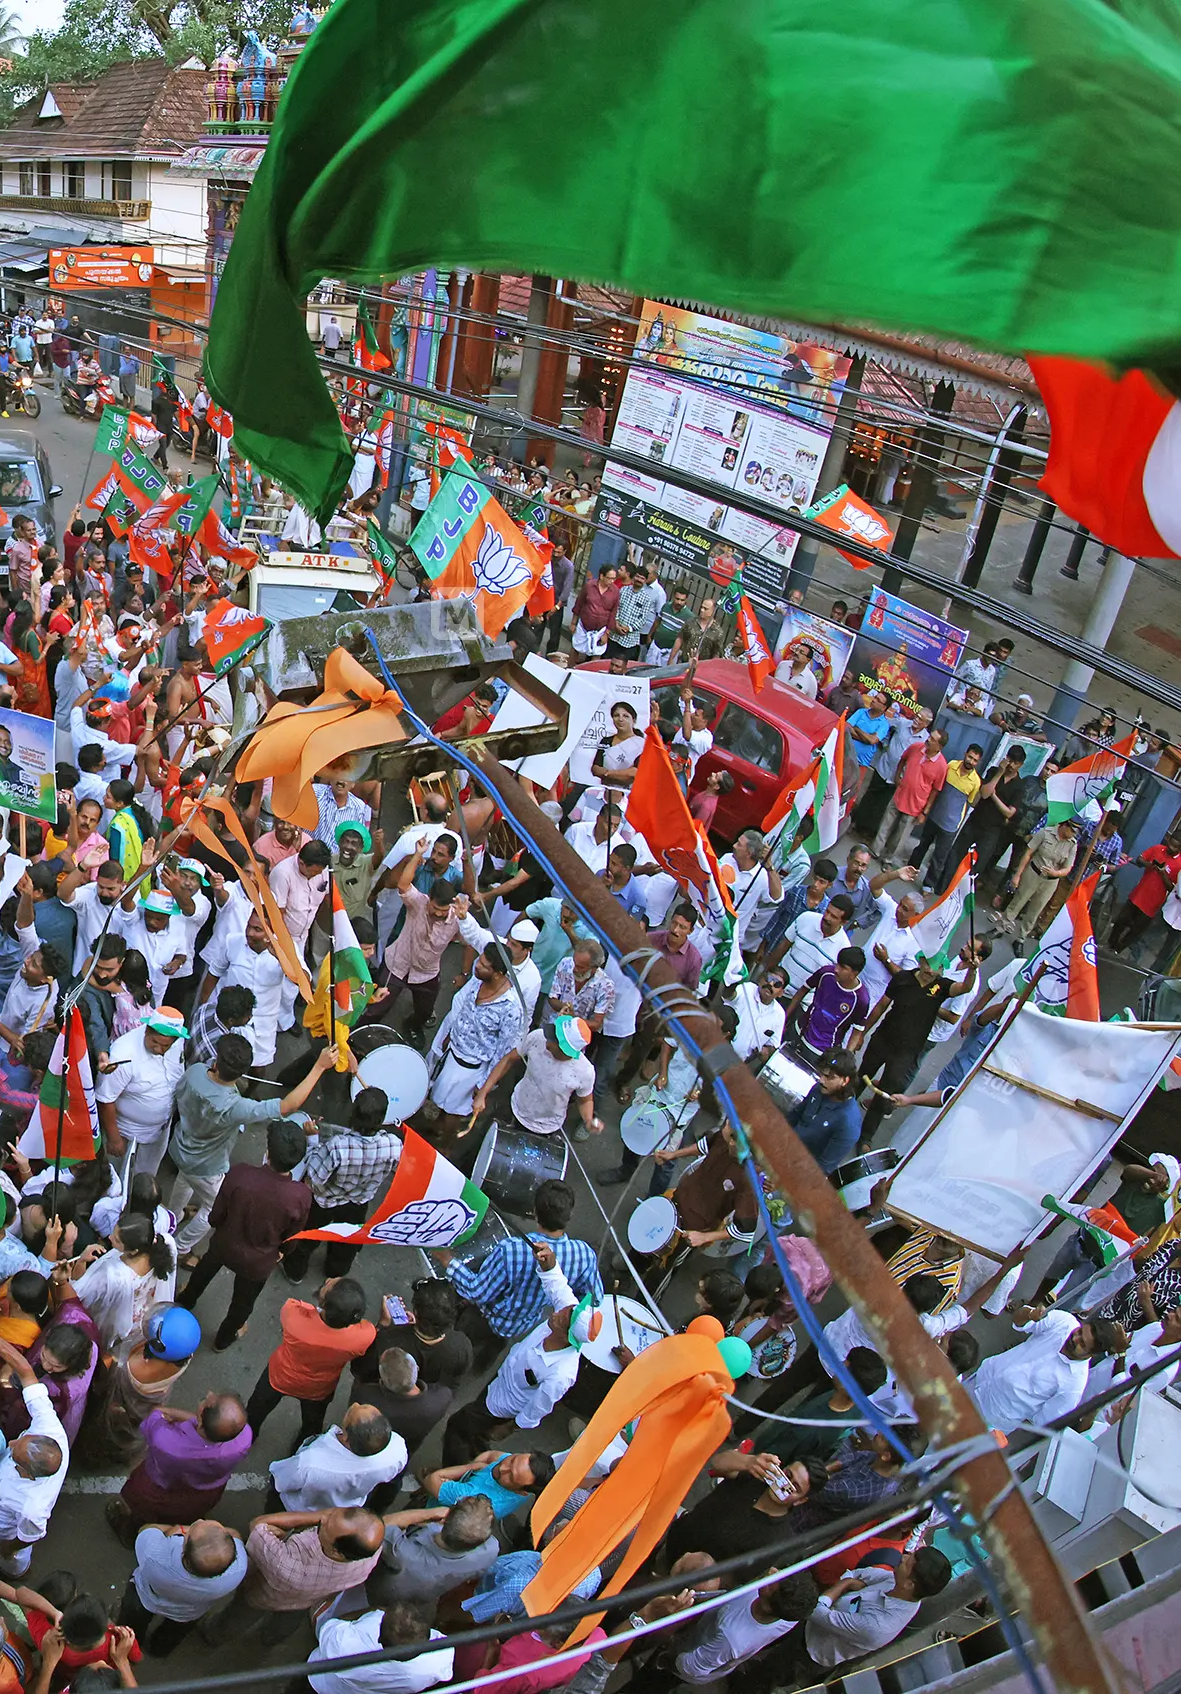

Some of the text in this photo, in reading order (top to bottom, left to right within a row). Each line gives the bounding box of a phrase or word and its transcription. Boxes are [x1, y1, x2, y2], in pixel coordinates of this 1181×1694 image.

[108, 413, 125, 451] BJP
[121, 447, 162, 490] BJP
[425, 480, 481, 562] BJP
[300, 555, 340, 568] ATK
[632, 685, 642, 694] 27
